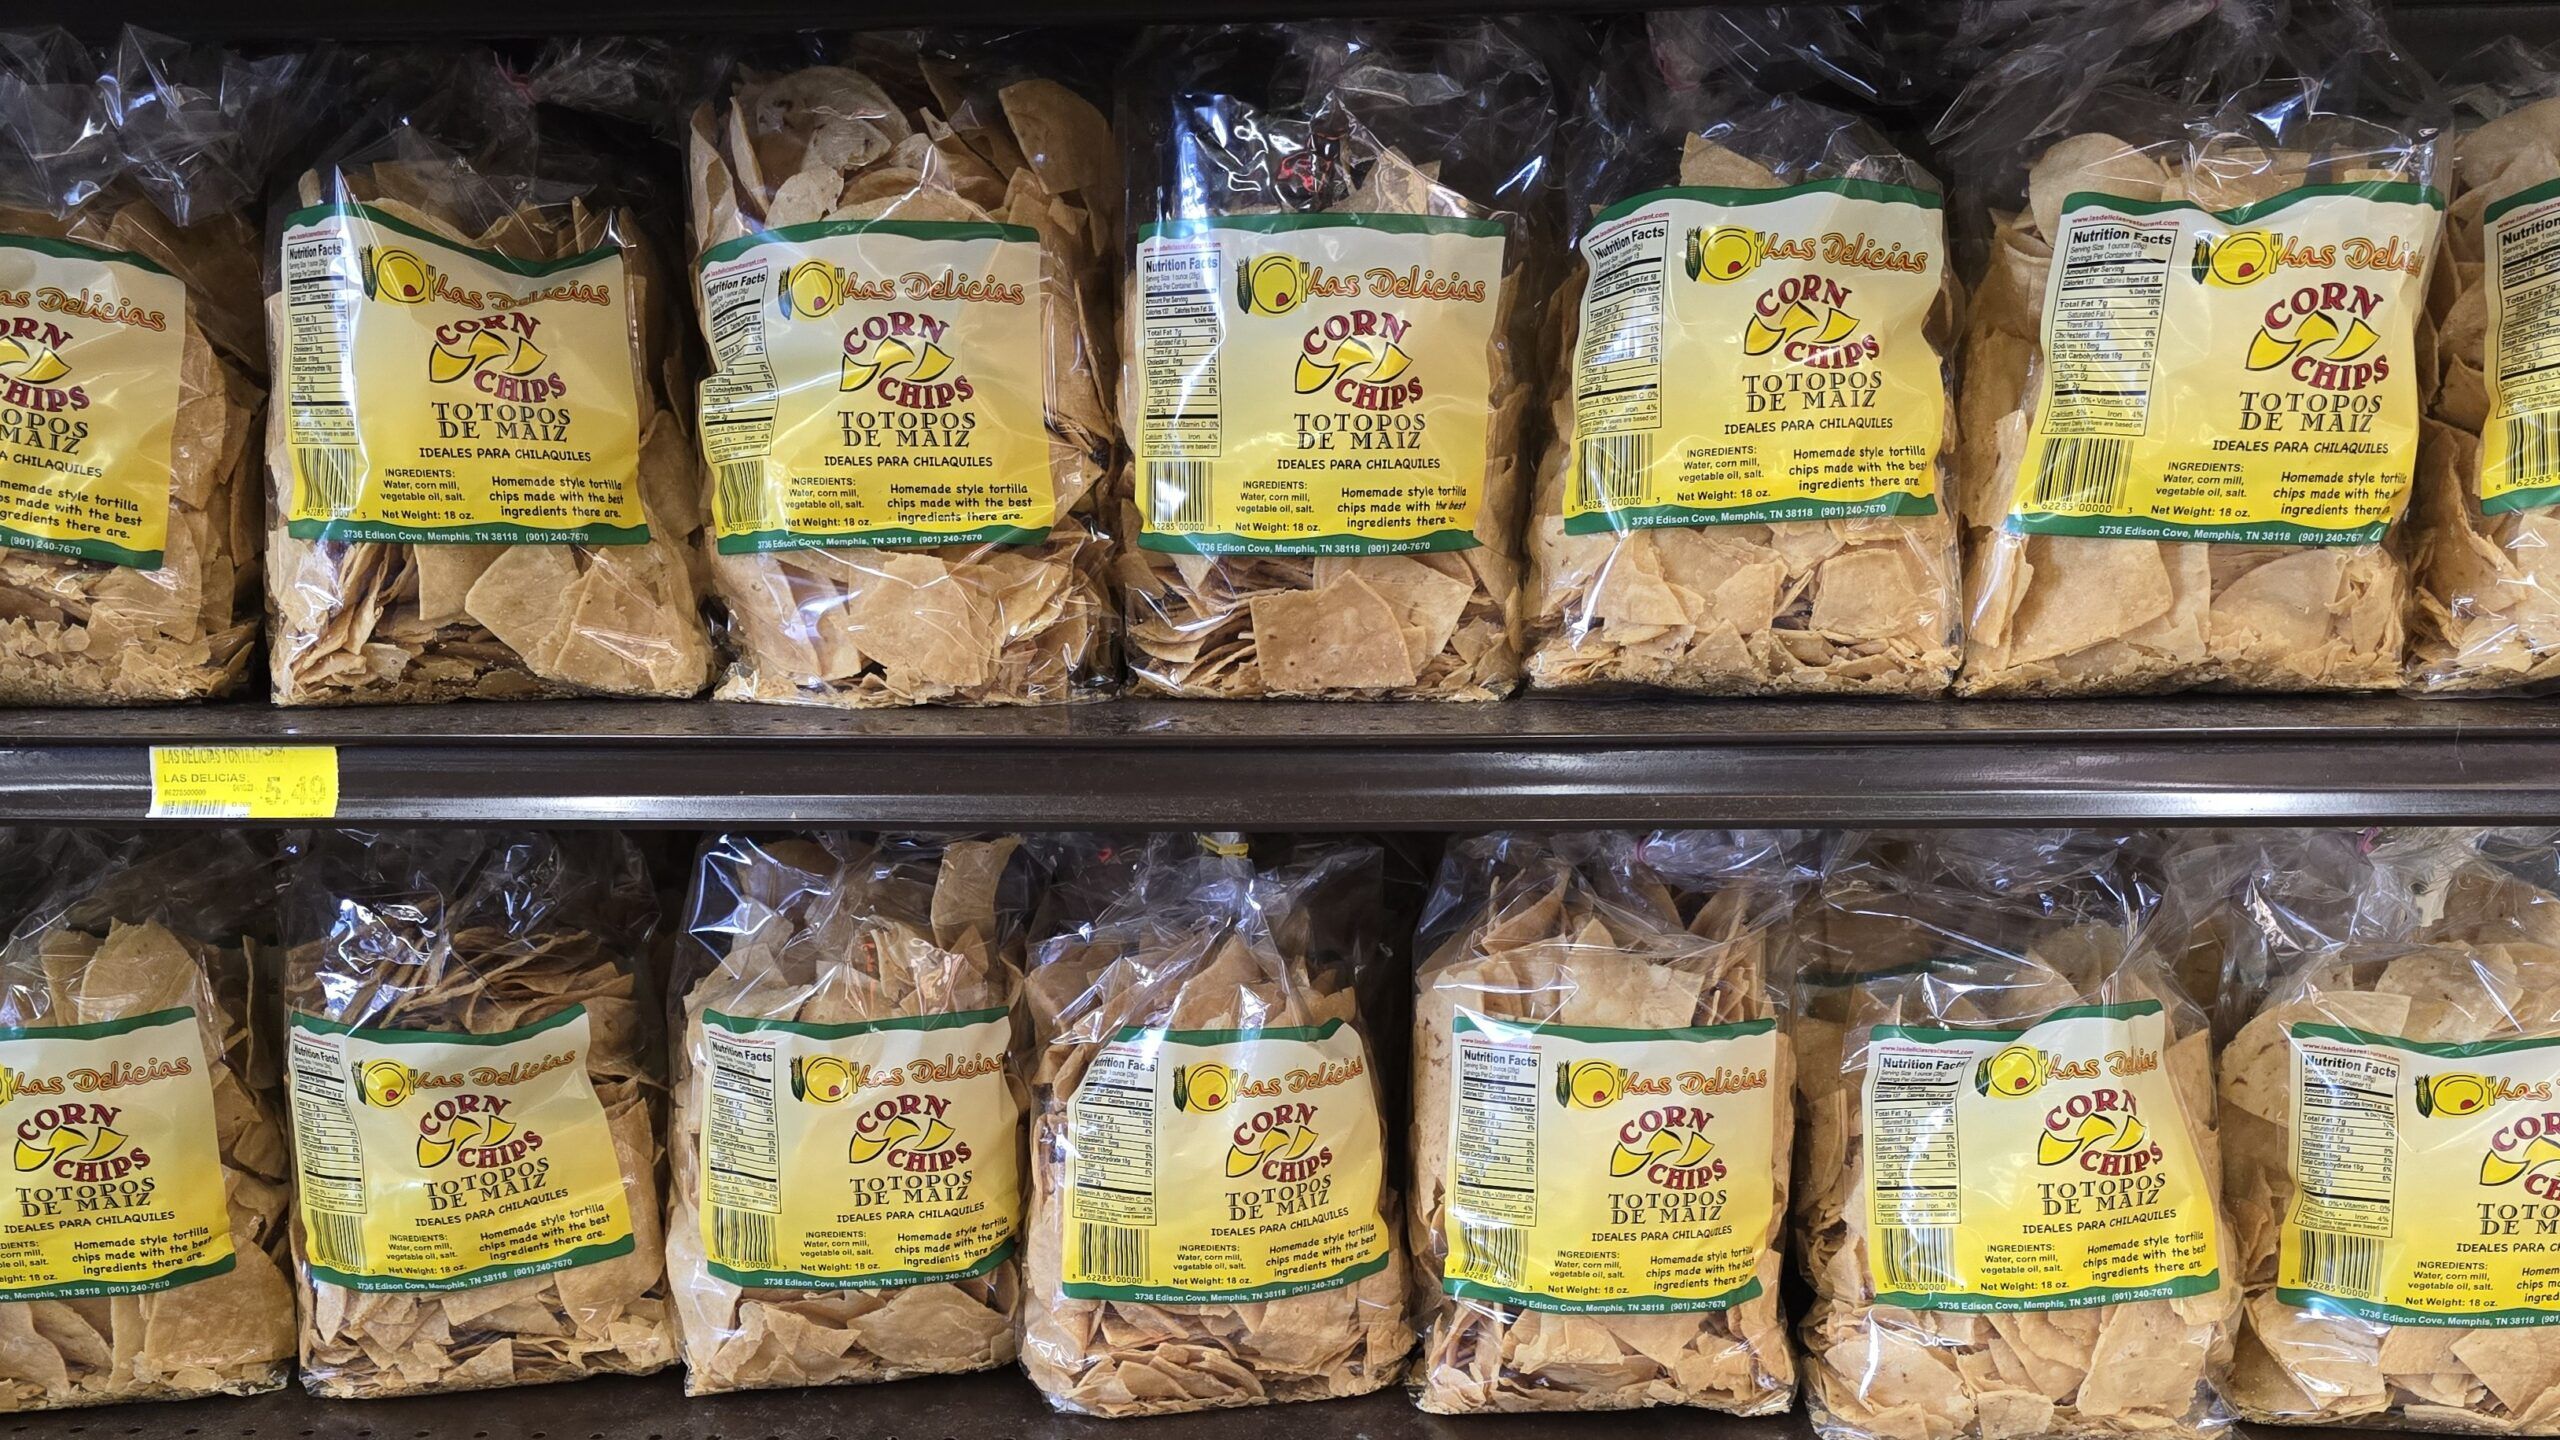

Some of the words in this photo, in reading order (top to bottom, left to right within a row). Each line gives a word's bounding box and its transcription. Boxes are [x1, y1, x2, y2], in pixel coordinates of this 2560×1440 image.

[2073, 228, 2129, 244] Nutrition
[2134, 232, 2172, 245] Facts
[1764, 233, 1815, 261] Las
[1824, 233, 1927, 274] Delicias
[2279, 238, 2334, 269] Las
[435, 276, 484, 310] Las
[844, 271, 895, 300] Las
[903, 268, 1025, 306] Delicias
[1308, 267, 1360, 298] Las
[1367, 266, 1486, 302] Delicias
[1756, 274, 1852, 316] CORN
[37, 287, 166, 332] Delicias
[2265, 283, 2383, 329] CORN
[436, 312, 541, 346] CORN
[843, 312, 950, 355] CORN
[1303, 310, 1411, 355] CORN
[1784, 334, 1879, 369] CHIPS
[1742, 371, 1882, 394] TOTOPOS
[2291, 355, 2390, 391] CHIPS
[474, 371, 566, 404] CHIPS
[878, 376, 974, 408] CHIPS
[1335, 377, 1423, 411] CHIPS
[431, 402, 571, 424] TOTOPOS
[1746, 394, 1786, 413] DE
[1803, 390, 1876, 410] MAIZ
[2239, 391, 2382, 413] TOTOPOS
[439, 421, 480, 439] DE
[496, 423, 568, 442] MAIZ
[838, 411, 976, 429] TOTOPOS
[1294, 413, 1425, 432] TOTOPOS
[2239, 412, 2282, 432] DE
[2300, 413, 2372, 433] MAIZ
[843, 430, 881, 447] DE
[897, 430, 970, 448] MAIZ
[1296, 432, 1335, 450] DE
[1351, 433, 1420, 450] MAIZ
[13, 454, 102, 478] CHILAQUILES
[385, 468, 455, 478] INGREDIENTS:
[824, 456, 873, 467] IDEALES
[877, 456, 909, 467] PARA
[913, 456, 993, 468] CHILAQUILES
[1341, 486, 1403, 498] Homemade
[1408, 486, 1433, 500] style
[1437, 485, 1467, 497] tortilla
[2516, 475, 2552, 488] 62285
[16, 496, 51, 510] made
[55, 503, 83, 516] with
[88, 507, 110, 520] the
[115, 510, 142, 527] best
[58, 488, 89, 503] style
[95, 493, 139, 512] tortilla
[2041, 501, 2075, 511] 62285
[2078, 503, 2112, 514] 00000
[382, 510, 399, 520] Net
[401, 509, 442, 521] Weight:
[444, 511, 455, 520] 18
[458, 512, 475, 520] oz.
[1632, 516, 1654, 525] 3736
[1656, 515, 1689, 524] Edison
[1692, 513, 1719, 524] Cove,
[1721, 511, 1767, 522] Memphis,
[1769, 510, 1783, 518] TN
[1785, 508, 1813, 518] 38118
[1821, 506, 1843, 518] (901)
[1845, 504, 1886, 515] 240-7670
[10, 536, 35, 548] (901)
[37, 541, 82, 555] 240-7670
[164, 774, 188, 783] LAS
[414, 1072, 464, 1090] Las
[469, 1049, 576, 1088] Delicias
[1464, 1050, 1505, 1065] Nutrition
[1508, 1055, 1538, 1066] Facts
[2048, 1056, 2101, 1081] Las
[2305, 1055, 2361, 1072] Nutrition
[2365, 1062, 2397, 1078] Facts
[13, 1071, 64, 1096] Las
[69, 1056, 192, 1092] Delicias
[858, 1060, 904, 1088] Las
[1236, 1072, 1282, 1097] Las
[1625, 1072, 1672, 1095] Las
[1676, 1067, 1767, 1095] Delicias
[2495, 1074, 2553, 1102] Las
[18, 1103, 121, 1141] CORN
[419, 1095, 511, 1136] CORN
[856, 1095, 951, 1134] CORN
[2045, 1089, 2138, 1131] CORN
[1233, 1103, 1318, 1146] CORN
[1620, 1106, 1714, 1144] CORN
[458, 1130, 543, 1168] CHIPS
[887, 1141, 972, 1173] CHIPS
[2080, 1141, 2163, 1176] CHIPS
[53, 1148, 150, 1182] CHIPS
[1262, 1146, 1332, 1183] CHIPS
[1648, 1158, 1727, 1189] CHIPS
[16, 1177, 156, 1203] TOTOPOS
[423, 1158, 549, 1197] TOTOPOS
[849, 1171, 972, 1193] TOTOPOS
[2038, 1173, 2166, 1198] TOTOPOS
[430, 1193, 467, 1210] DE
[481, 1174, 547, 1202] MAIZ
[855, 1191, 889, 1207] DE
[904, 1186, 969, 1202] MAIZ
[1225, 1175, 1332, 1207] TOTOPOS
[1608, 1190, 1727, 1209] TOTOPOS
[2043, 1198, 2081, 1215] DE
[2096, 1190, 2160, 1212] MAIZ
[22, 1201, 61, 1217] DE
[78, 1193, 151, 1212] MAIZ
[837, 1212, 882, 1223] IDEALES
[886, 1210, 915, 1221] PARA
[918, 1202, 984, 1220] CHILAQUILES
[1229, 1205, 1264, 1221] DE
[1277, 1190, 1330, 1216] MAIZ
[1611, 1209, 1647, 1225] DE
[1660, 1206, 1722, 1223] MAIZ
[480, 1222, 537, 1241] Homemade
[540, 1213, 566, 1228] style
[570, 1204, 604, 1220] tortilla
[2481, 1219, 2520, 1235] DE
[74, 1238, 136, 1250] Homemade
[140, 1235, 168, 1247] style
[173, 1227, 209, 1241] tortilla
[2456, 1243, 2508, 1253] IDEALES
[2513, 1243, 2545, 1252] PARA
[1177, 1254, 1203, 1263] Water,
[1225, 1254, 1242, 1262] mill,
[2083, 1256, 2109, 1268] chips
[2111, 1253, 2139, 1265] made
[2143, 1250, 2167, 1261] with
[2172, 1248, 2189, 1258] the
[2417, 1261, 2488, 1270] INGREDIENTS:
[1550, 1270, 1589, 1279] vegetable
[1591, 1271, 1605, 1279] oil,
[2307, 1282, 2336, 1293] 62285
[2405, 1297, 2425, 1306] Net
[2427, 1297, 2466, 1308] Weight:
